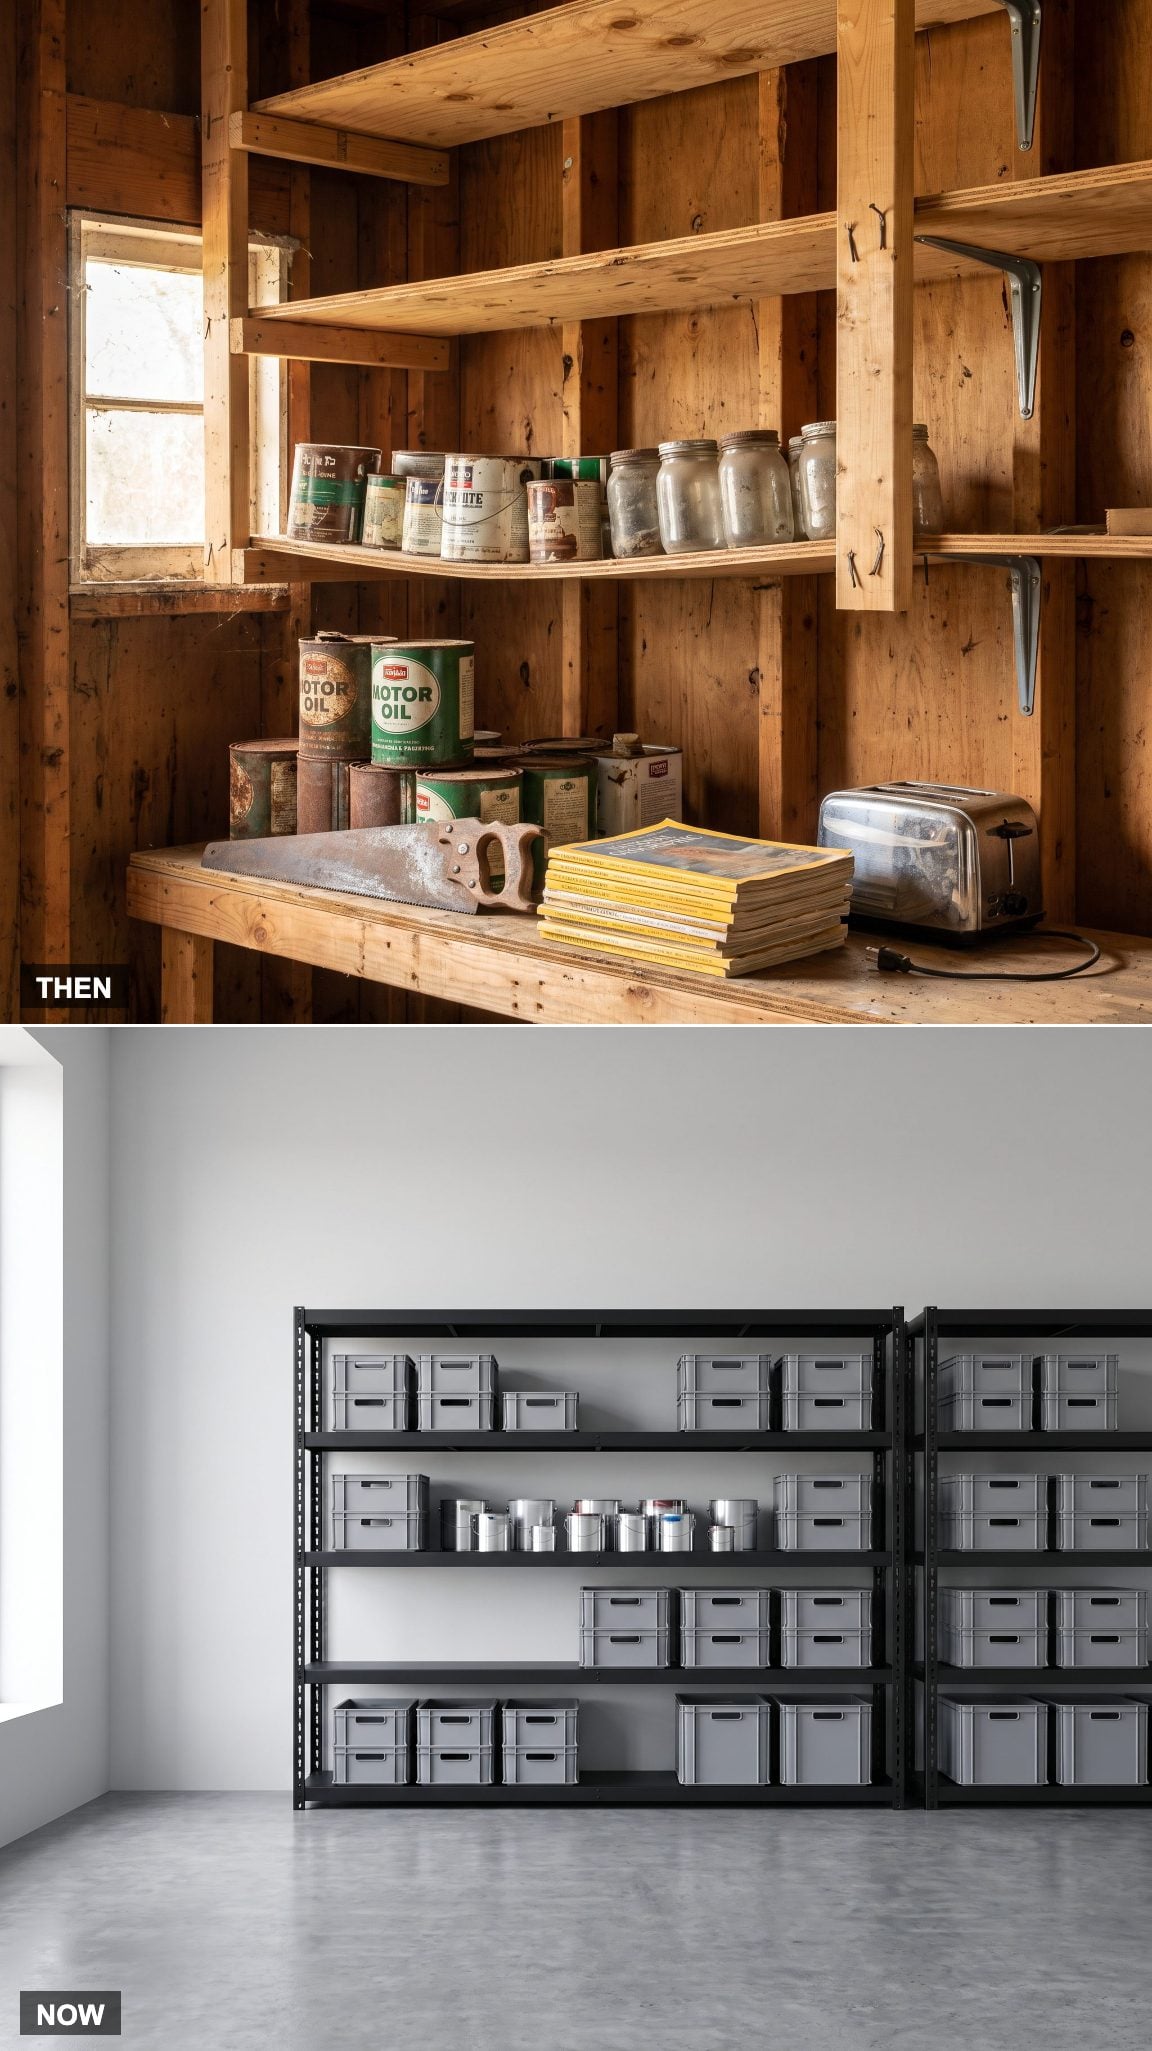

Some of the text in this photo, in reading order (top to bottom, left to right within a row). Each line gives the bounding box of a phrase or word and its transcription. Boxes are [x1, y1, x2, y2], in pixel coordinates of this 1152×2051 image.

[373, 685, 432, 702] MOTOR
[304, 696, 330, 712] OIL
[381, 703, 411, 719] OIL
